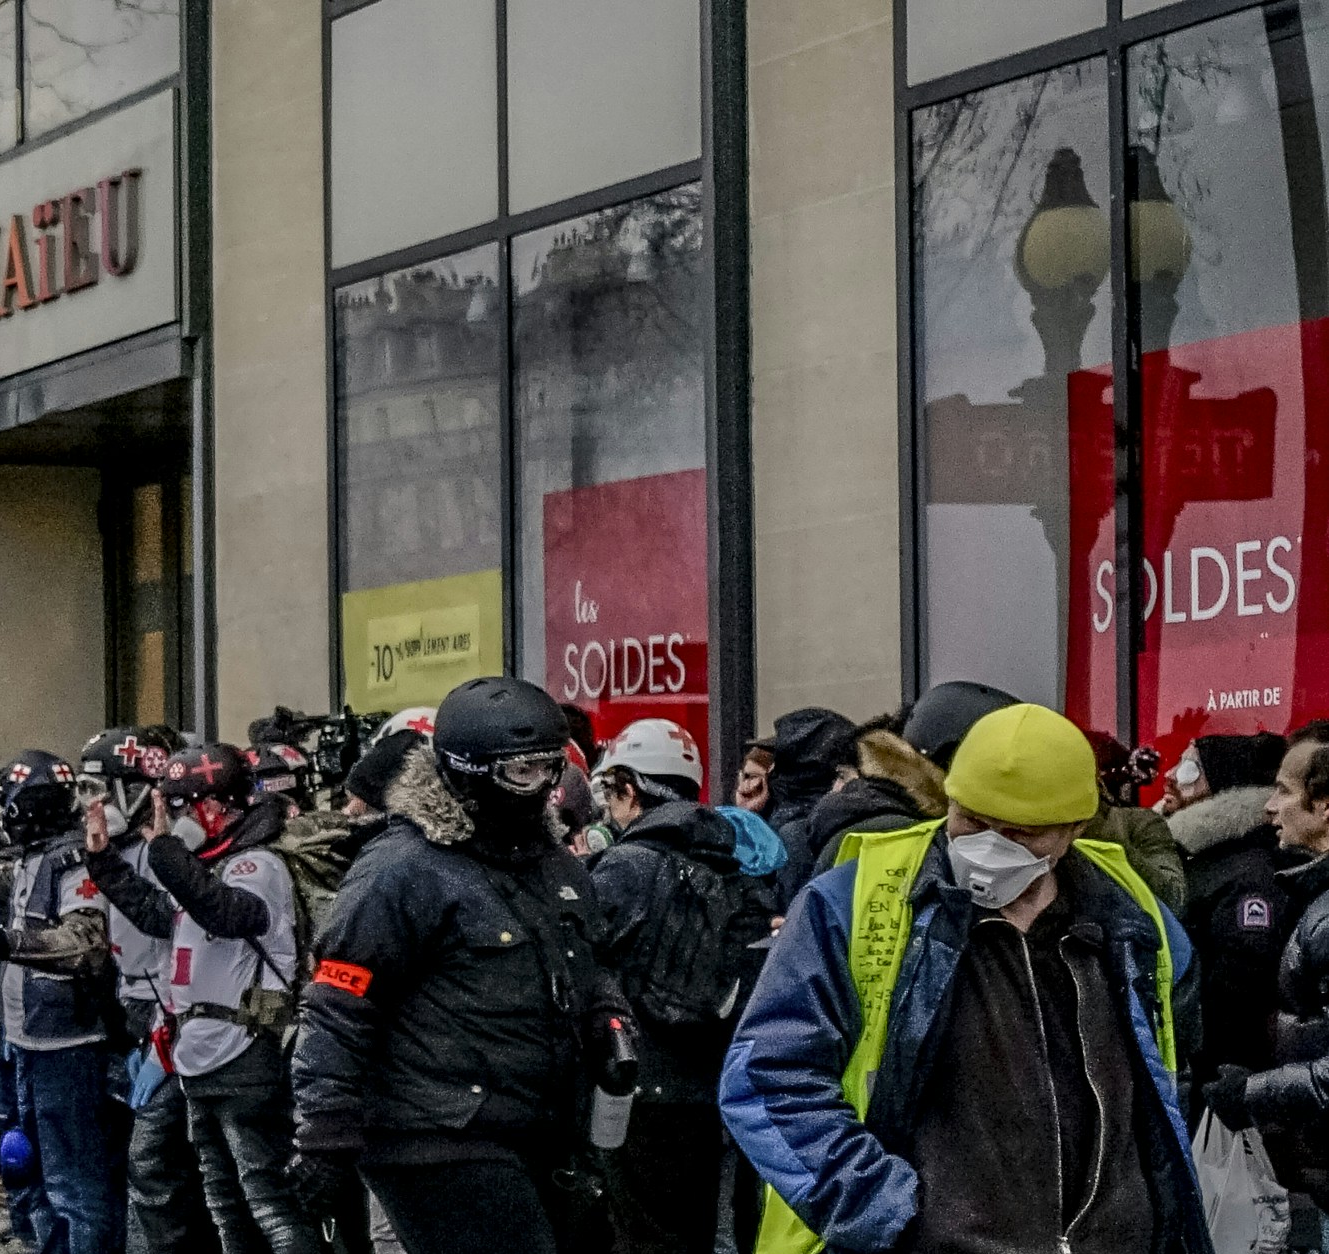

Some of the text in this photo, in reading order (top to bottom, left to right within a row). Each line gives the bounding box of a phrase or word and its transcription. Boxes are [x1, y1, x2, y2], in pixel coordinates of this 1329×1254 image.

[1207, 686, 1281, 711] À PARTIR DE
[322, 965, 363, 989] OLICE
